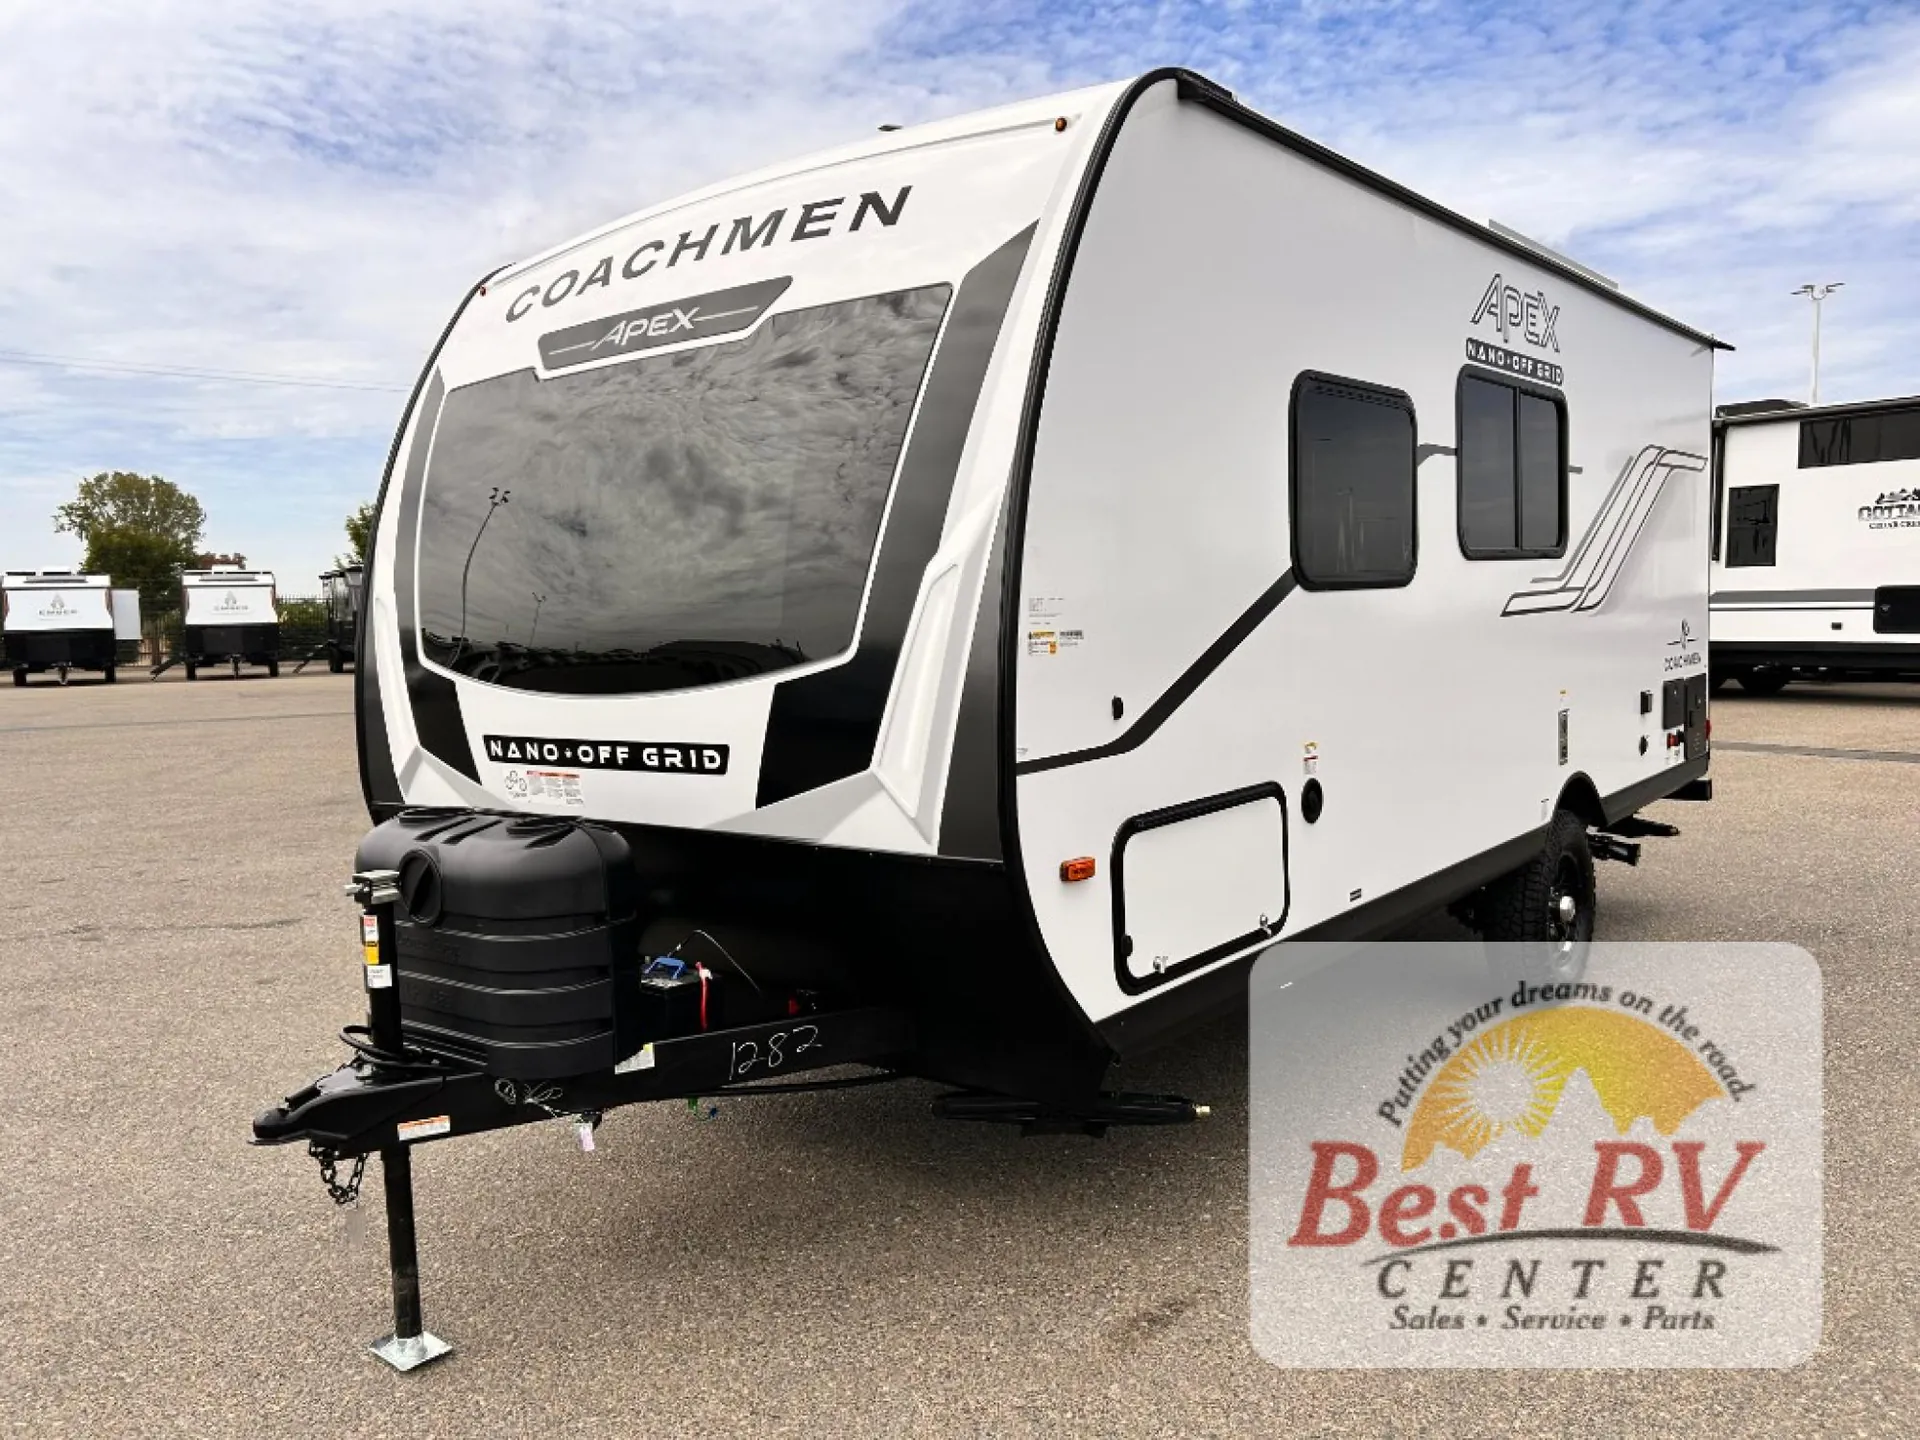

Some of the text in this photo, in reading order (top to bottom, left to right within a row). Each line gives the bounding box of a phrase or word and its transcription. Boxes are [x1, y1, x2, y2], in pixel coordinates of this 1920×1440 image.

[505, 184, 913, 323] COACHMEN
[592, 307, 700, 351] APEX
[1470, 273, 1560, 353] APEX
[1467, 342, 1562, 384] NANO OFF GRID
[1858, 504, 1920, 521] COTTA
[491, 740, 721, 769] NANO OFF GRID
[729, 1024, 823, 1081] 1282
